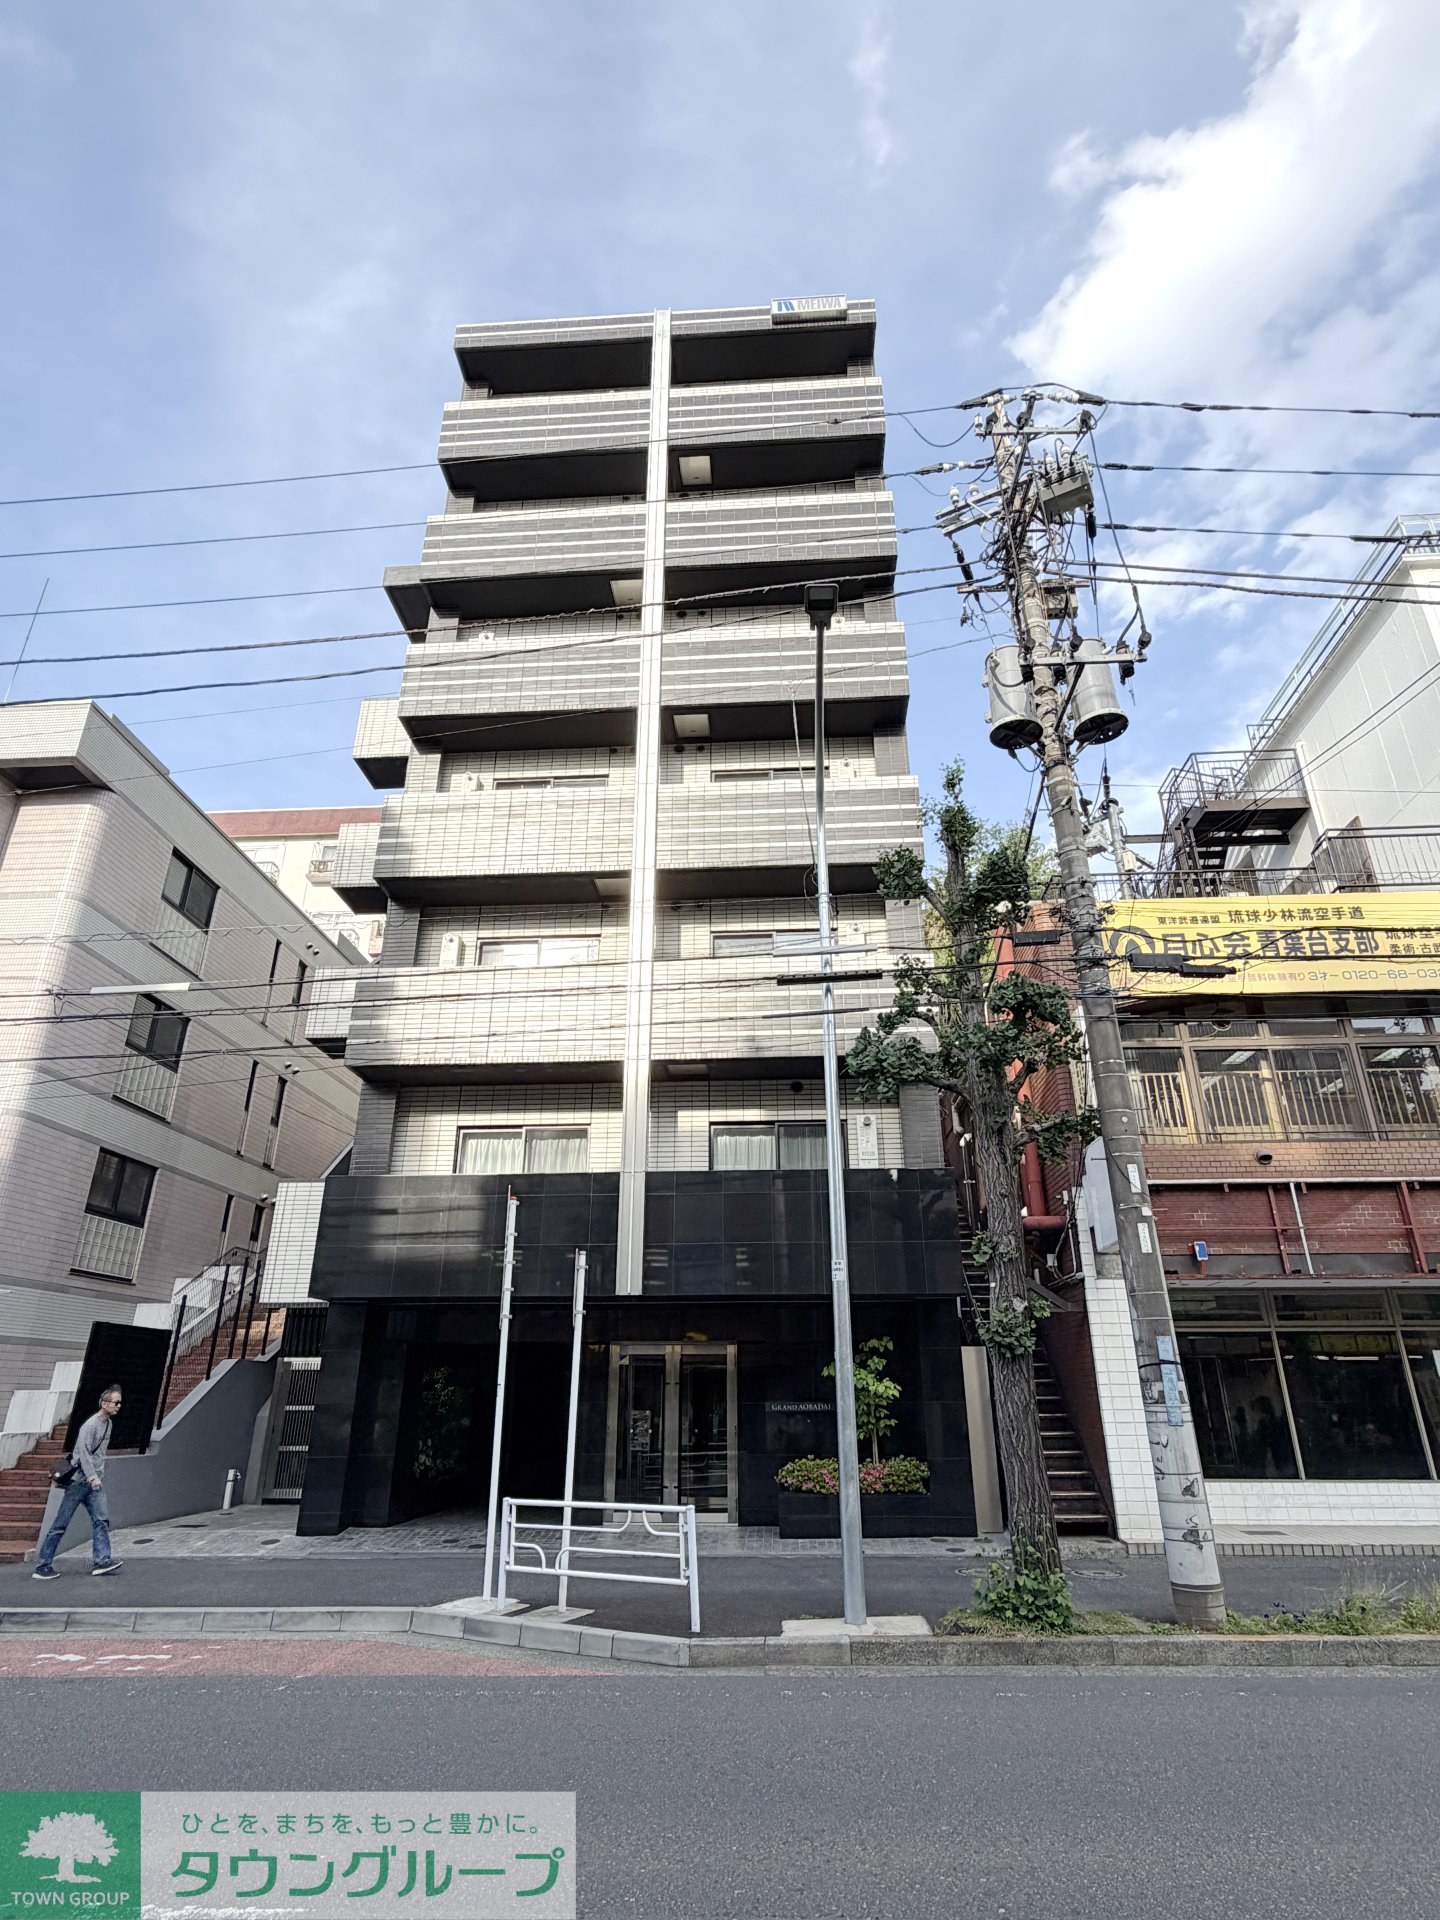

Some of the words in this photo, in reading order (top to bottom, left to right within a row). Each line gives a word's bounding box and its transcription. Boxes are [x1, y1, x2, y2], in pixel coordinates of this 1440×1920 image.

[797, 297, 842, 310] MEIWA
[1227, 906, 1365, 924] 琉球少林流空手道
[771, 1403, 798, 1411] GRAND
[799, 1402, 831, 1410] AOBADAI
